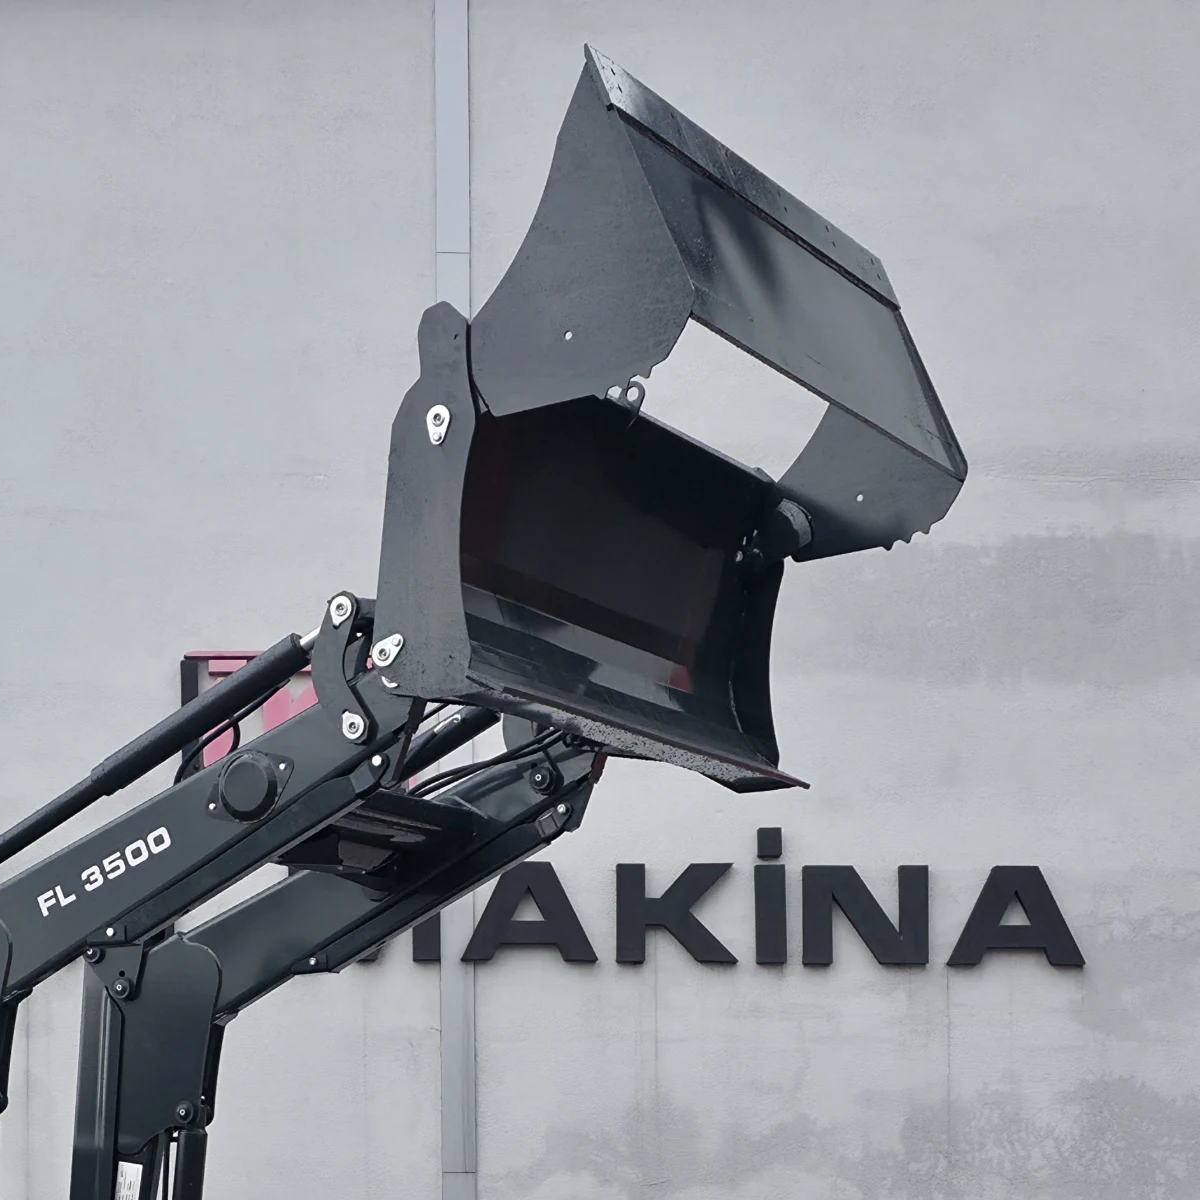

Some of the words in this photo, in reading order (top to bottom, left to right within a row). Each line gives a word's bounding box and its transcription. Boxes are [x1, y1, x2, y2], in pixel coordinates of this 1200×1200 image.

[37, 885, 77, 917] FL
[81, 826, 172, 892] 3500
[356, 827, 1086, 966] AKİNA
